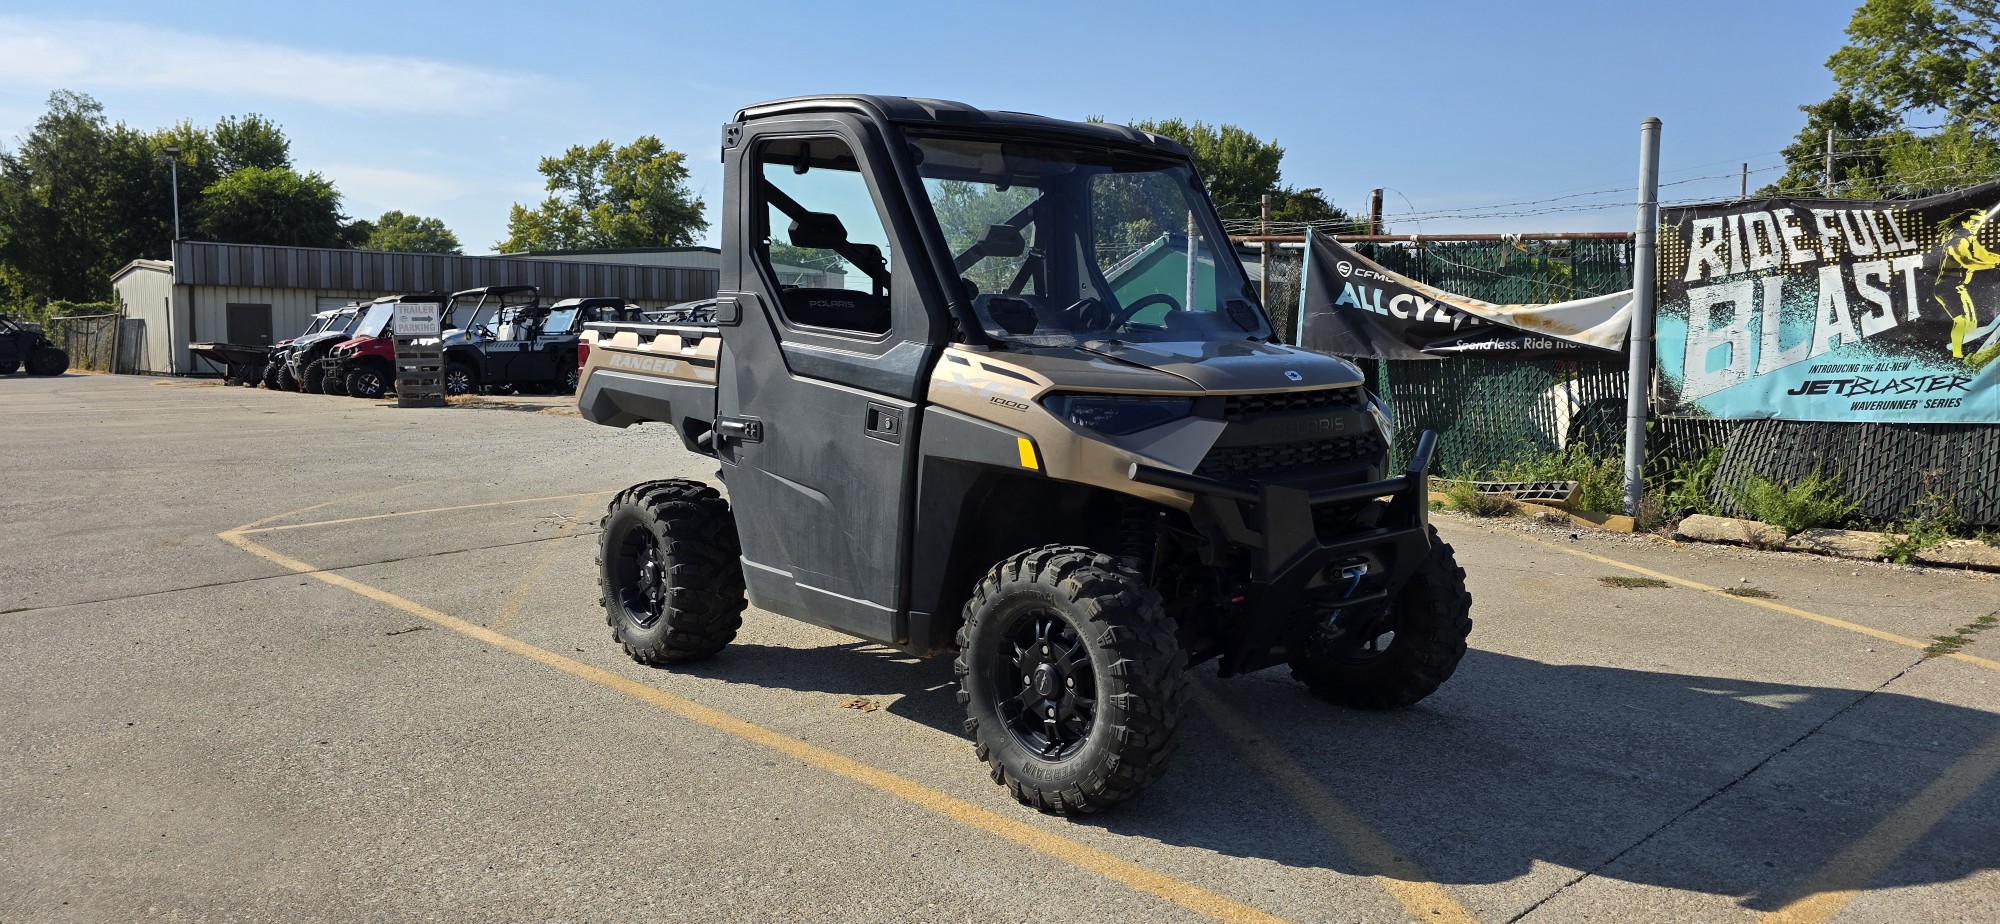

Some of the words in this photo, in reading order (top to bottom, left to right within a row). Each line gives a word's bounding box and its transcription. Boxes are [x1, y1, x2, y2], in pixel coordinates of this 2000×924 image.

[1684, 208, 1816, 282] RIDE
[1809, 208, 1917, 259] FULL
[396, 305, 434, 315] TRAILER
[809, 300, 855, 308] POLARIS
[398, 323, 435, 332] PARKING
[1681, 254, 1923, 402] BLAST
[1494, 337, 1520, 350] less.
[1523, 337, 1552, 349] Ride
[609, 354, 677, 374] RANGER
[1808, 363, 1860, 375] INTRODUCING
[1861, 364, 1873, 372] THE
[1874, 362, 1912, 371] ALL-NEW
[937, 372, 1026, 397] XP
[989, 396, 1030, 410] 1000
[1923, 398, 1963, 409] SERIES
